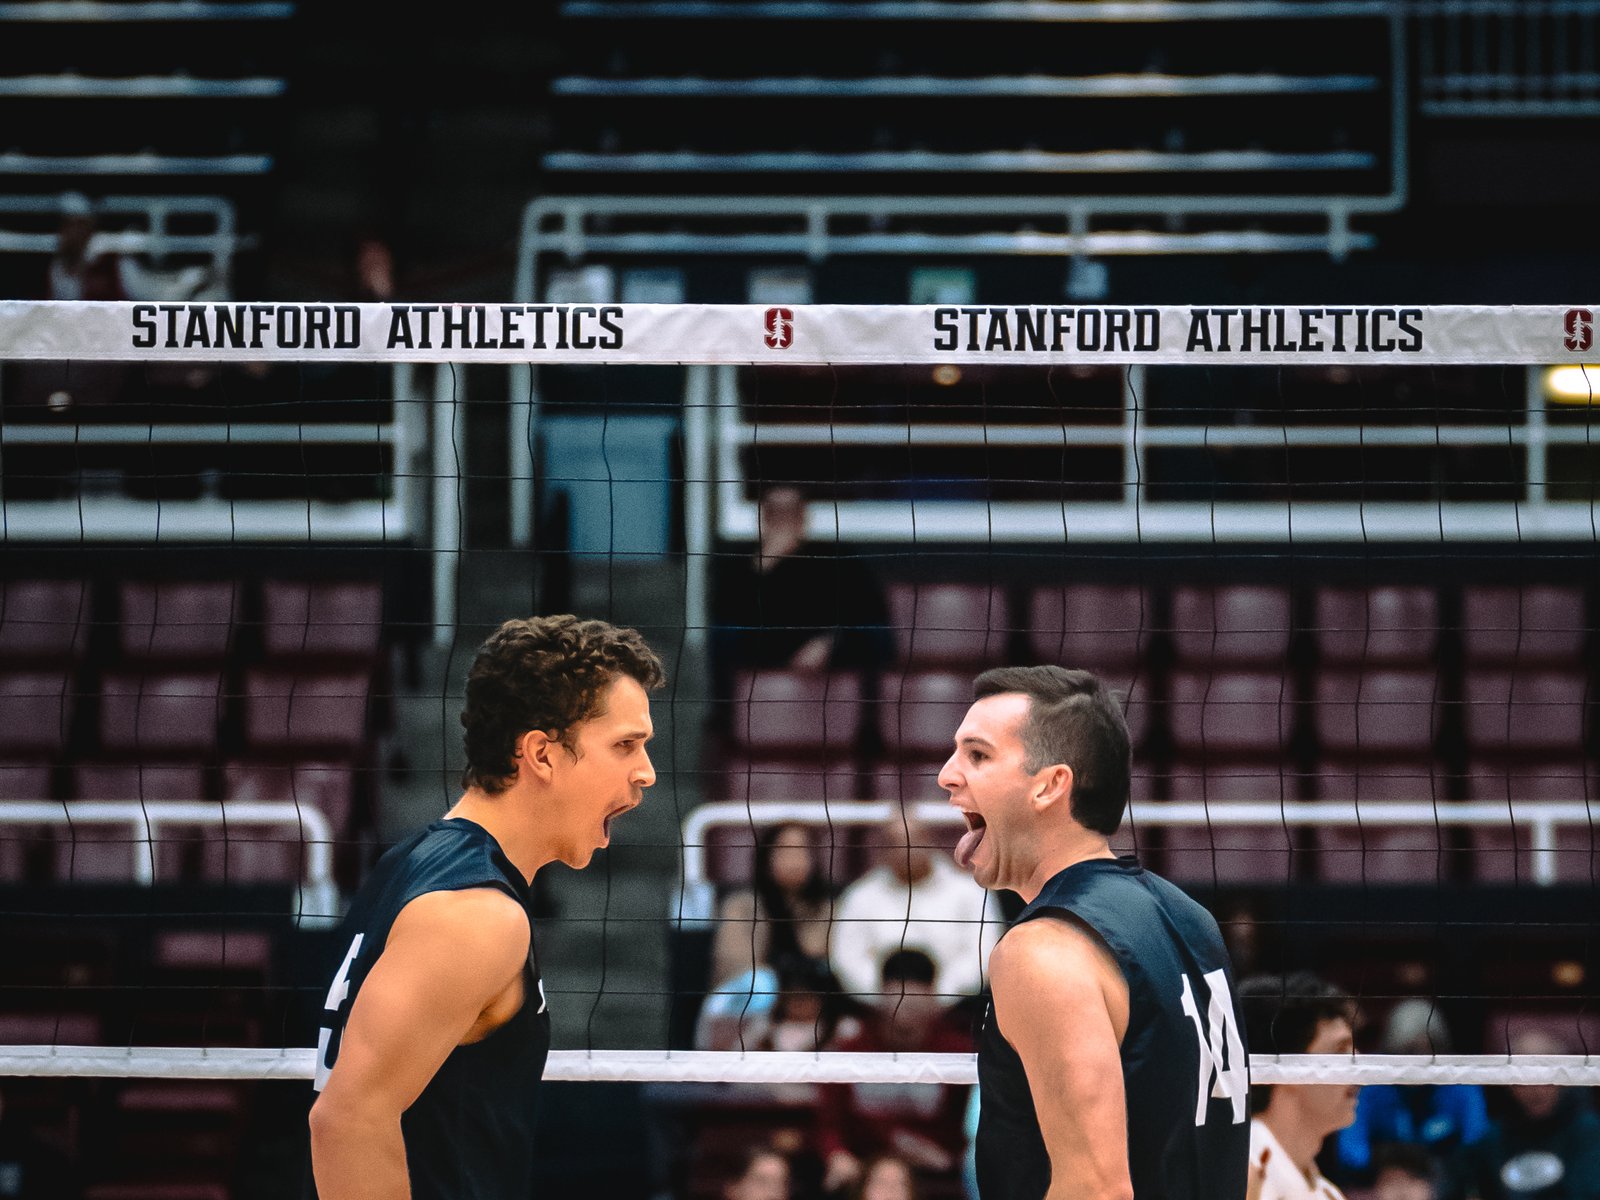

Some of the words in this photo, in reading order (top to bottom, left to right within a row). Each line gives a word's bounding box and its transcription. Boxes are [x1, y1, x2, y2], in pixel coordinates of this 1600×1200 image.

[132, 305, 361, 349] STANFORD
[386, 306, 624, 349] ATHLETICS
[934, 308, 1161, 352] STANFORD
[1186, 308, 1424, 352] ATHLETICS
[1180, 968, 1249, 1127] 14
